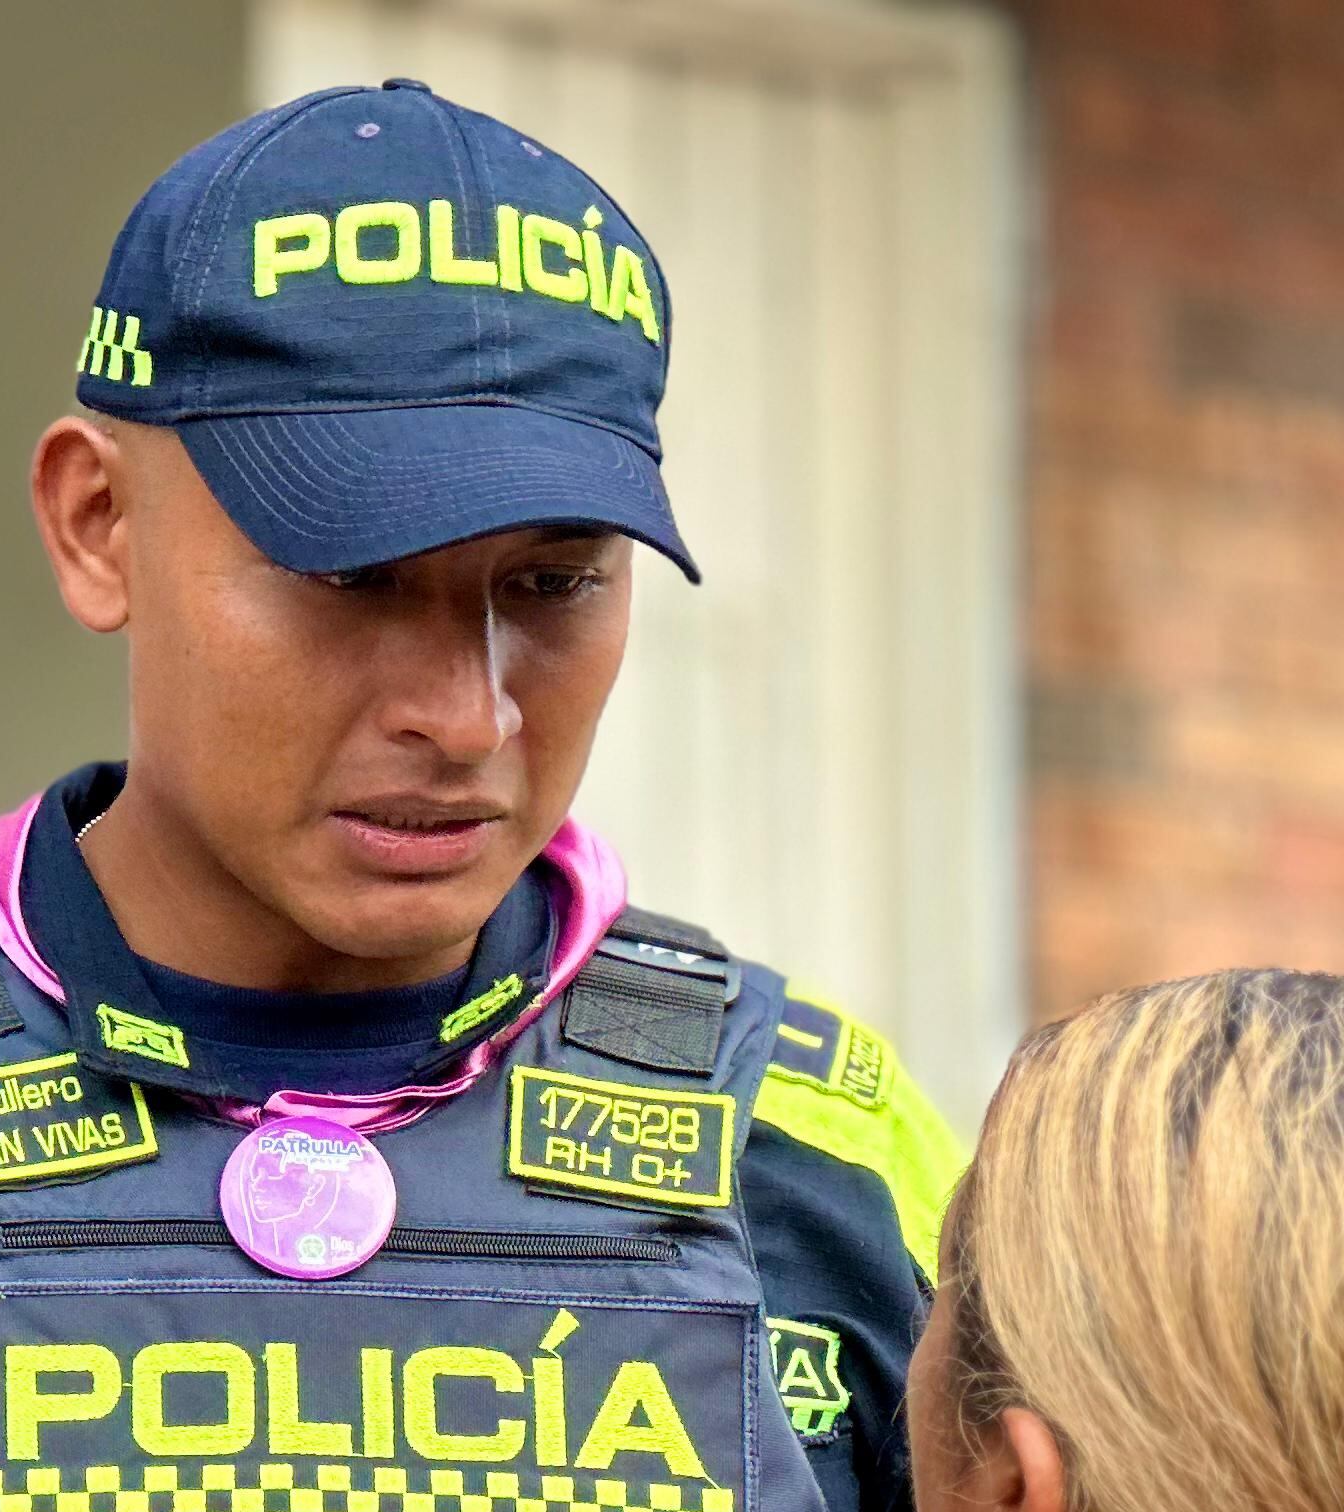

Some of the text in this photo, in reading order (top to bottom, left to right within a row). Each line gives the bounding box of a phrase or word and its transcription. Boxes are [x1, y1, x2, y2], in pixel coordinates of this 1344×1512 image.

[253, 199, 661, 344] POLICÍA
[31, 1112, 126, 1159] VIVAS
[261, 1138, 361, 1157] PATRULLA
[538, 1086, 702, 1153] 177528
[544, 1134, 613, 1177] RH
[4, 1308, 711, 1480] POLICÍA
